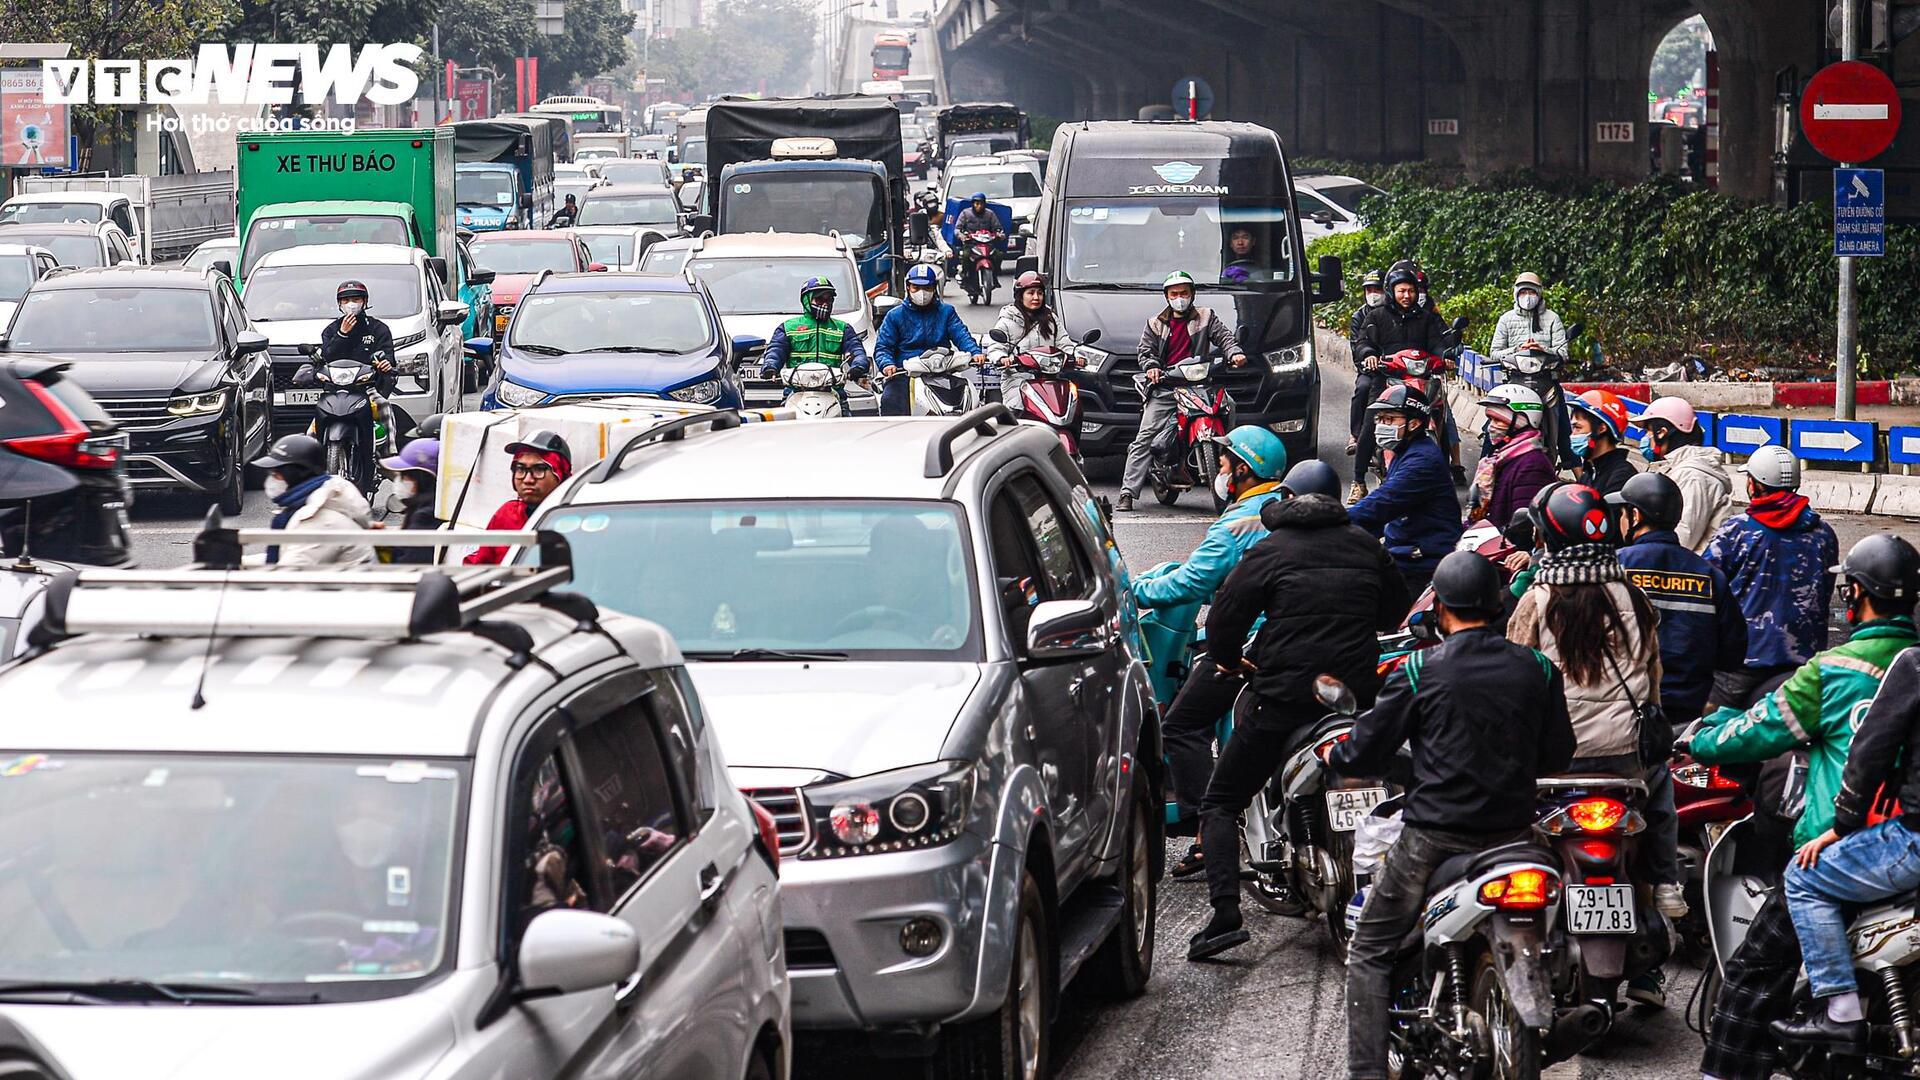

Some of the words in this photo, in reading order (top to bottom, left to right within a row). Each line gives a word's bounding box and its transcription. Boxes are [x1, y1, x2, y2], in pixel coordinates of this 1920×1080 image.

[1600, 123, 1632, 141] T175
[277, 155, 301, 173] XE
[306, 153, 347, 172] THƯ
[352, 150, 396, 171] BÁO
[1837, 201, 1855, 217] TUYẾN
[1875, 203, 1883, 217] CÓ
[1836, 220, 1850, 233] GIÁM
[1870, 223, 1883, 236] PHẠT
[1839, 235, 1855, 251] BẰNG
[1856, 240, 1880, 252] CAMERA
[1631, 574, 1705, 593] SECURITY
[1336, 791, 1379, 810] 29-V1
[1577, 888, 1625, 908] 29-L1
[1574, 910, 1633, 931] 477.83
